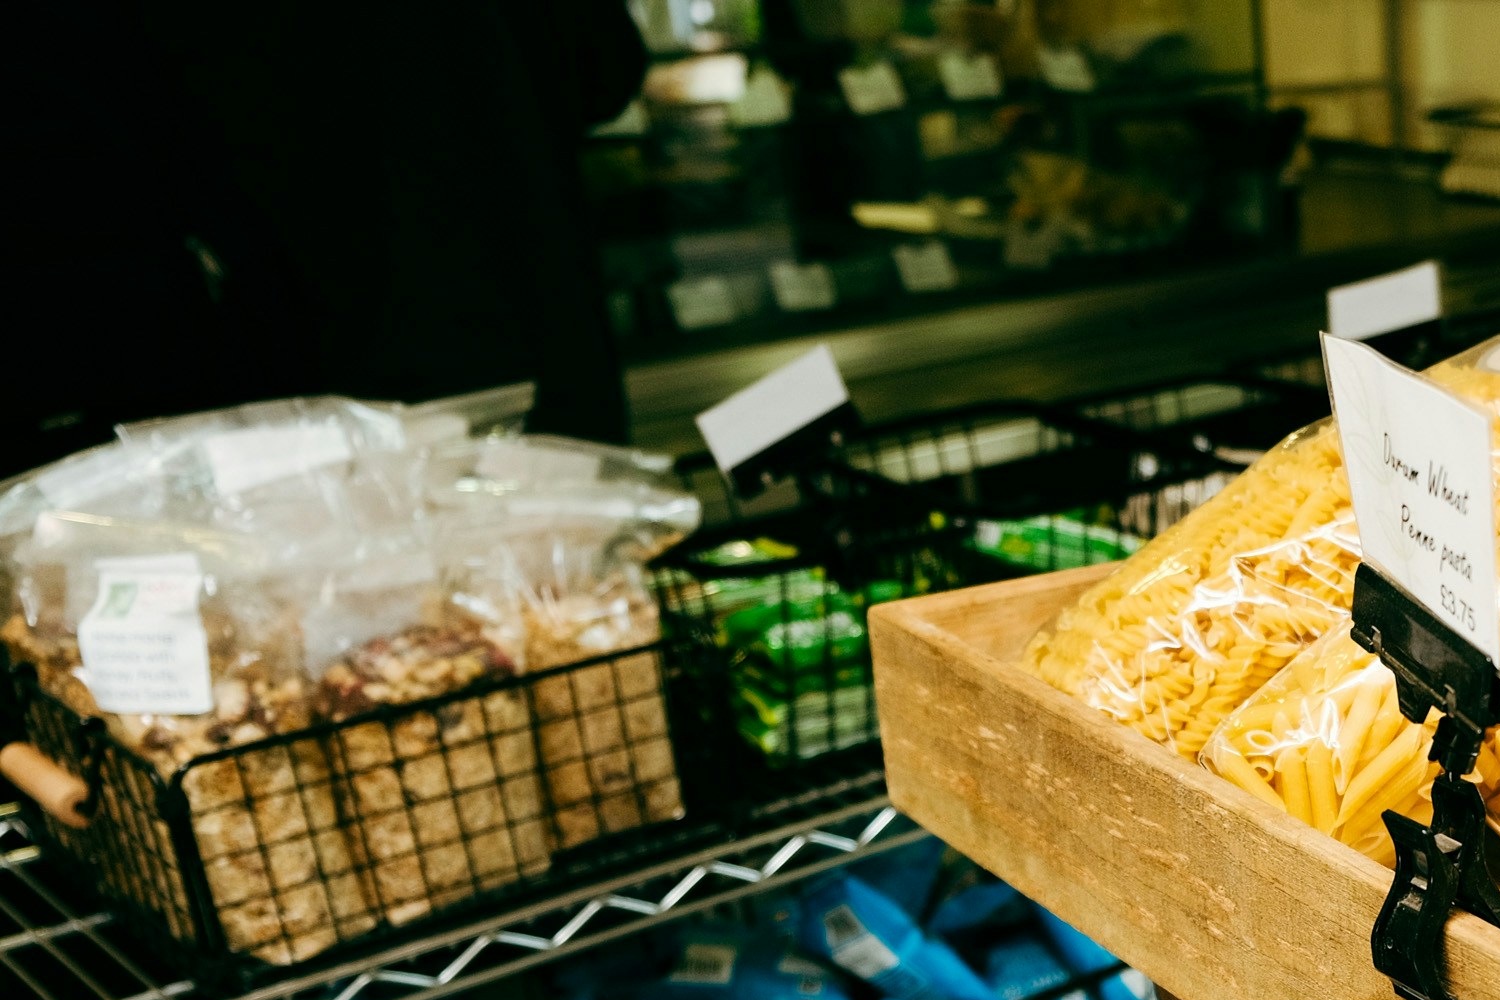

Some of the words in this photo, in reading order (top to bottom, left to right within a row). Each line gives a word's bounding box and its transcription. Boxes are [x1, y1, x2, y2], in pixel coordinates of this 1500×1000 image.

[1383, 432, 1419, 486] Durum
[1427, 459, 1469, 516] Wheat
[1401, 503, 1436, 552] Penne
[1439, 543, 1472, 583] pasta
[1440, 583, 1476, 632] £3.75
